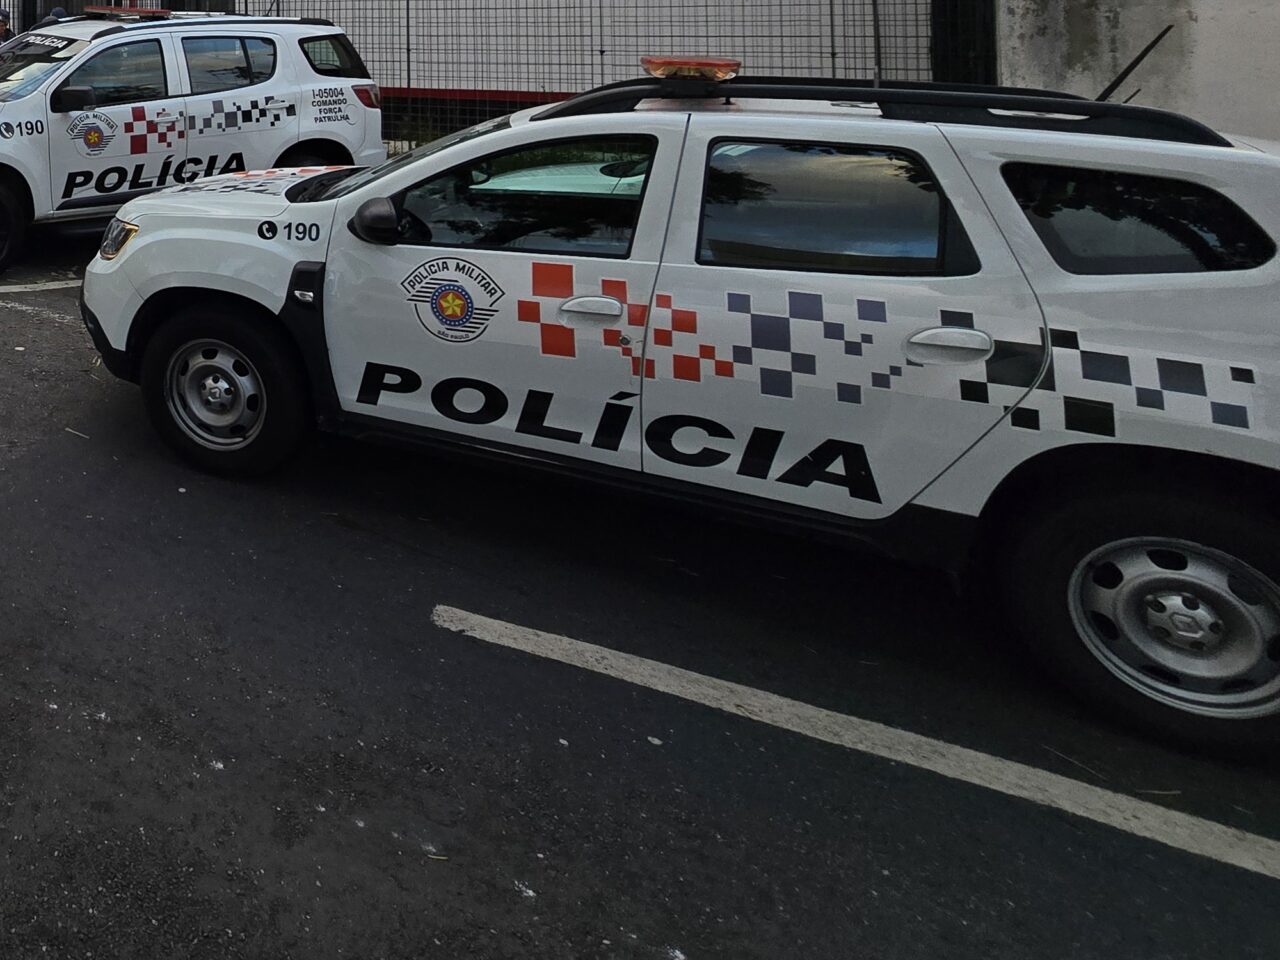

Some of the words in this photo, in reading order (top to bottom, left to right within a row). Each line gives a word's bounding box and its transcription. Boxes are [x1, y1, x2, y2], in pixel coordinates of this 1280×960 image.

[24, 36, 68, 48] POLÍCIA
[312, 87, 344, 99] I-05004
[311, 98, 348, 107] COMANDO
[318, 107, 343, 115] FORÇA
[69, 113, 90, 134] POLÍCIA
[92, 113, 115, 131] MILITAR
[314, 114, 351, 123] PATRULHA
[16, 119, 45, 137] 190
[61, 152, 246, 199] POLÍCIA
[283, 222, 320, 241] 190
[407, 261, 450, 290] POLÍCIA
[454, 261, 498, 298] MILITAR
[355, 360, 883, 505] POLÍCIA
